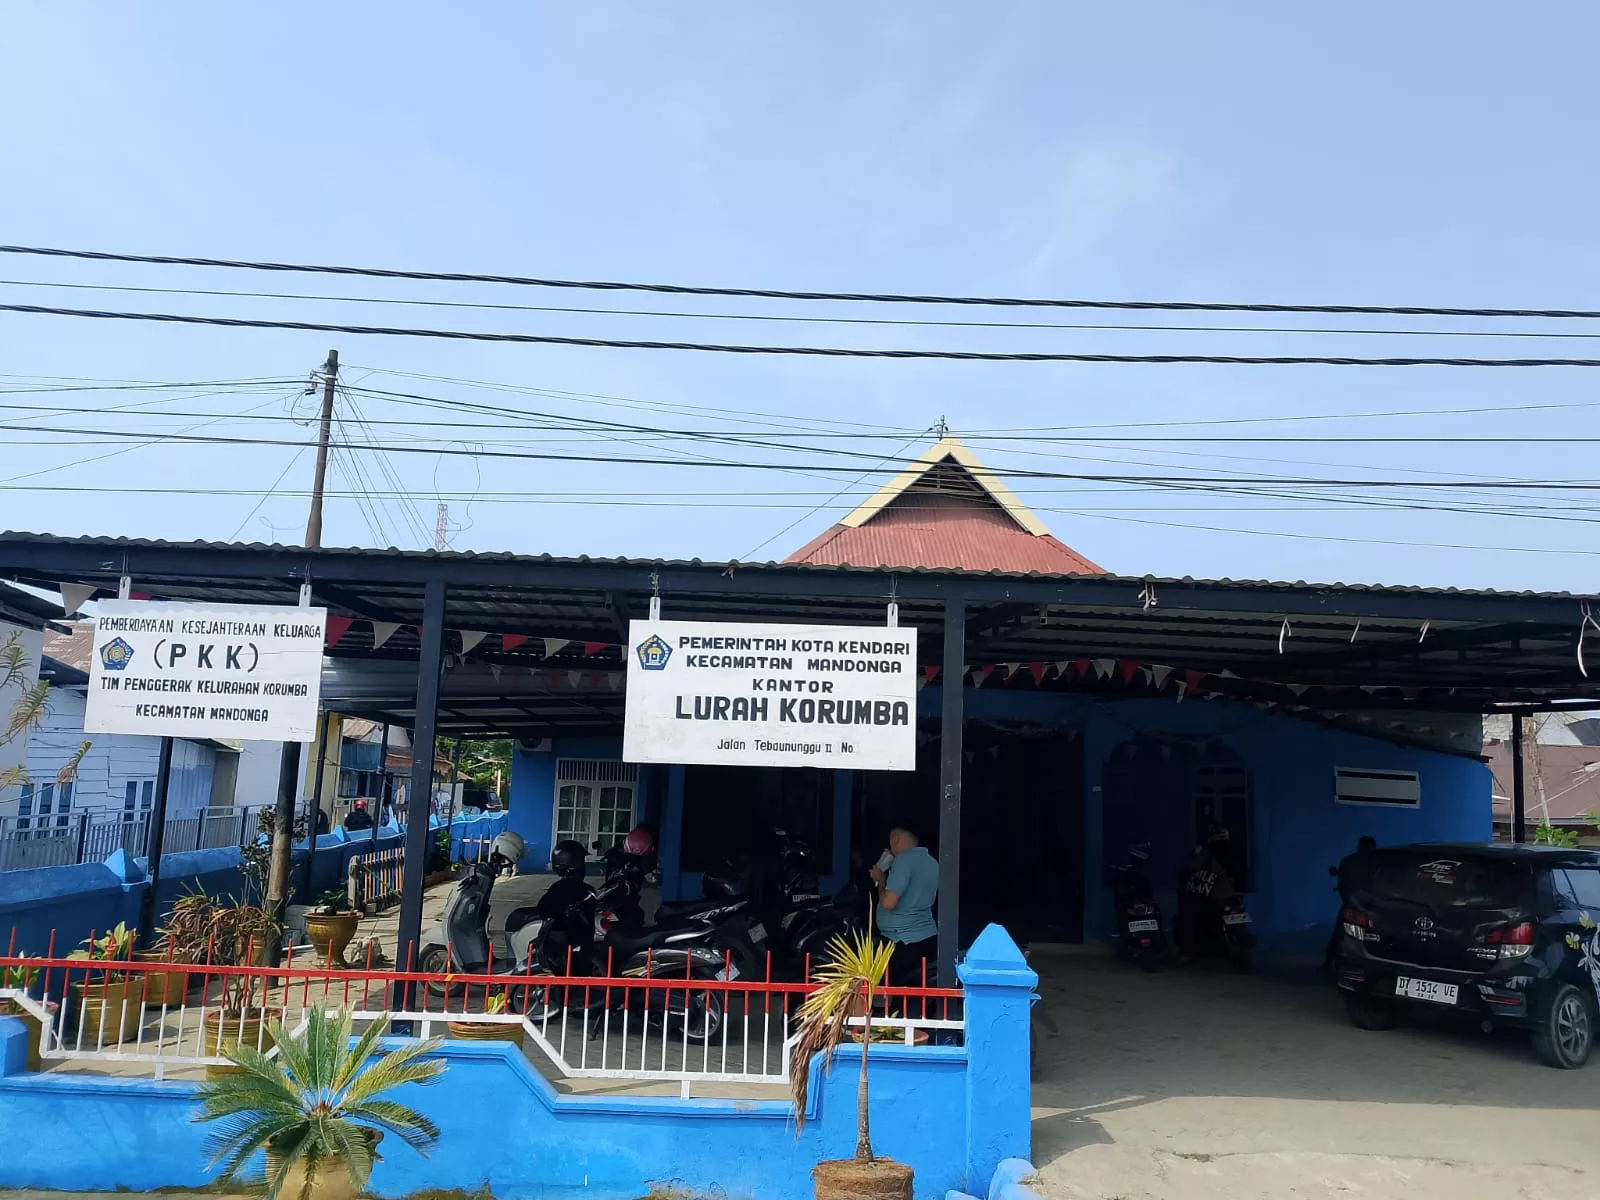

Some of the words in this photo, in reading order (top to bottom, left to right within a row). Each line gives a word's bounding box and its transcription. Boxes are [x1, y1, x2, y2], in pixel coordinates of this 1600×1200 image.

[181, 620, 266, 637] KESEJAHTERAAN
[274, 623, 321, 638] KELUARGA
[679, 636, 786, 651] PEMERINTAH
[791, 639, 834, 653] KOTA
[838, 641, 909, 655] KENDARI
[686, 655, 792, 669] KECAMATAN
[808, 659, 902, 672] MANDONGA
[101, 677, 119, 690] TIM
[124, 677, 192, 692] PENGGERAK
[197, 680, 259, 695] KELURAHAN
[264, 683, 308, 696] KORUMBA
[752, 679, 834, 693] KANTOR
[136, 704, 205, 719] KECAMATAN
[210, 708, 269, 722] MANDONGA
[675, 695, 768, 721] LURAH
[780, 698, 909, 726] KORUMBA
[717, 739, 745, 750] Jalan
[754, 739, 821, 754] Tebaununggu
[841, 742, 853, 753] No
[1415, 981, 1438, 993] 1514
[1444, 986, 1456, 997] VE
